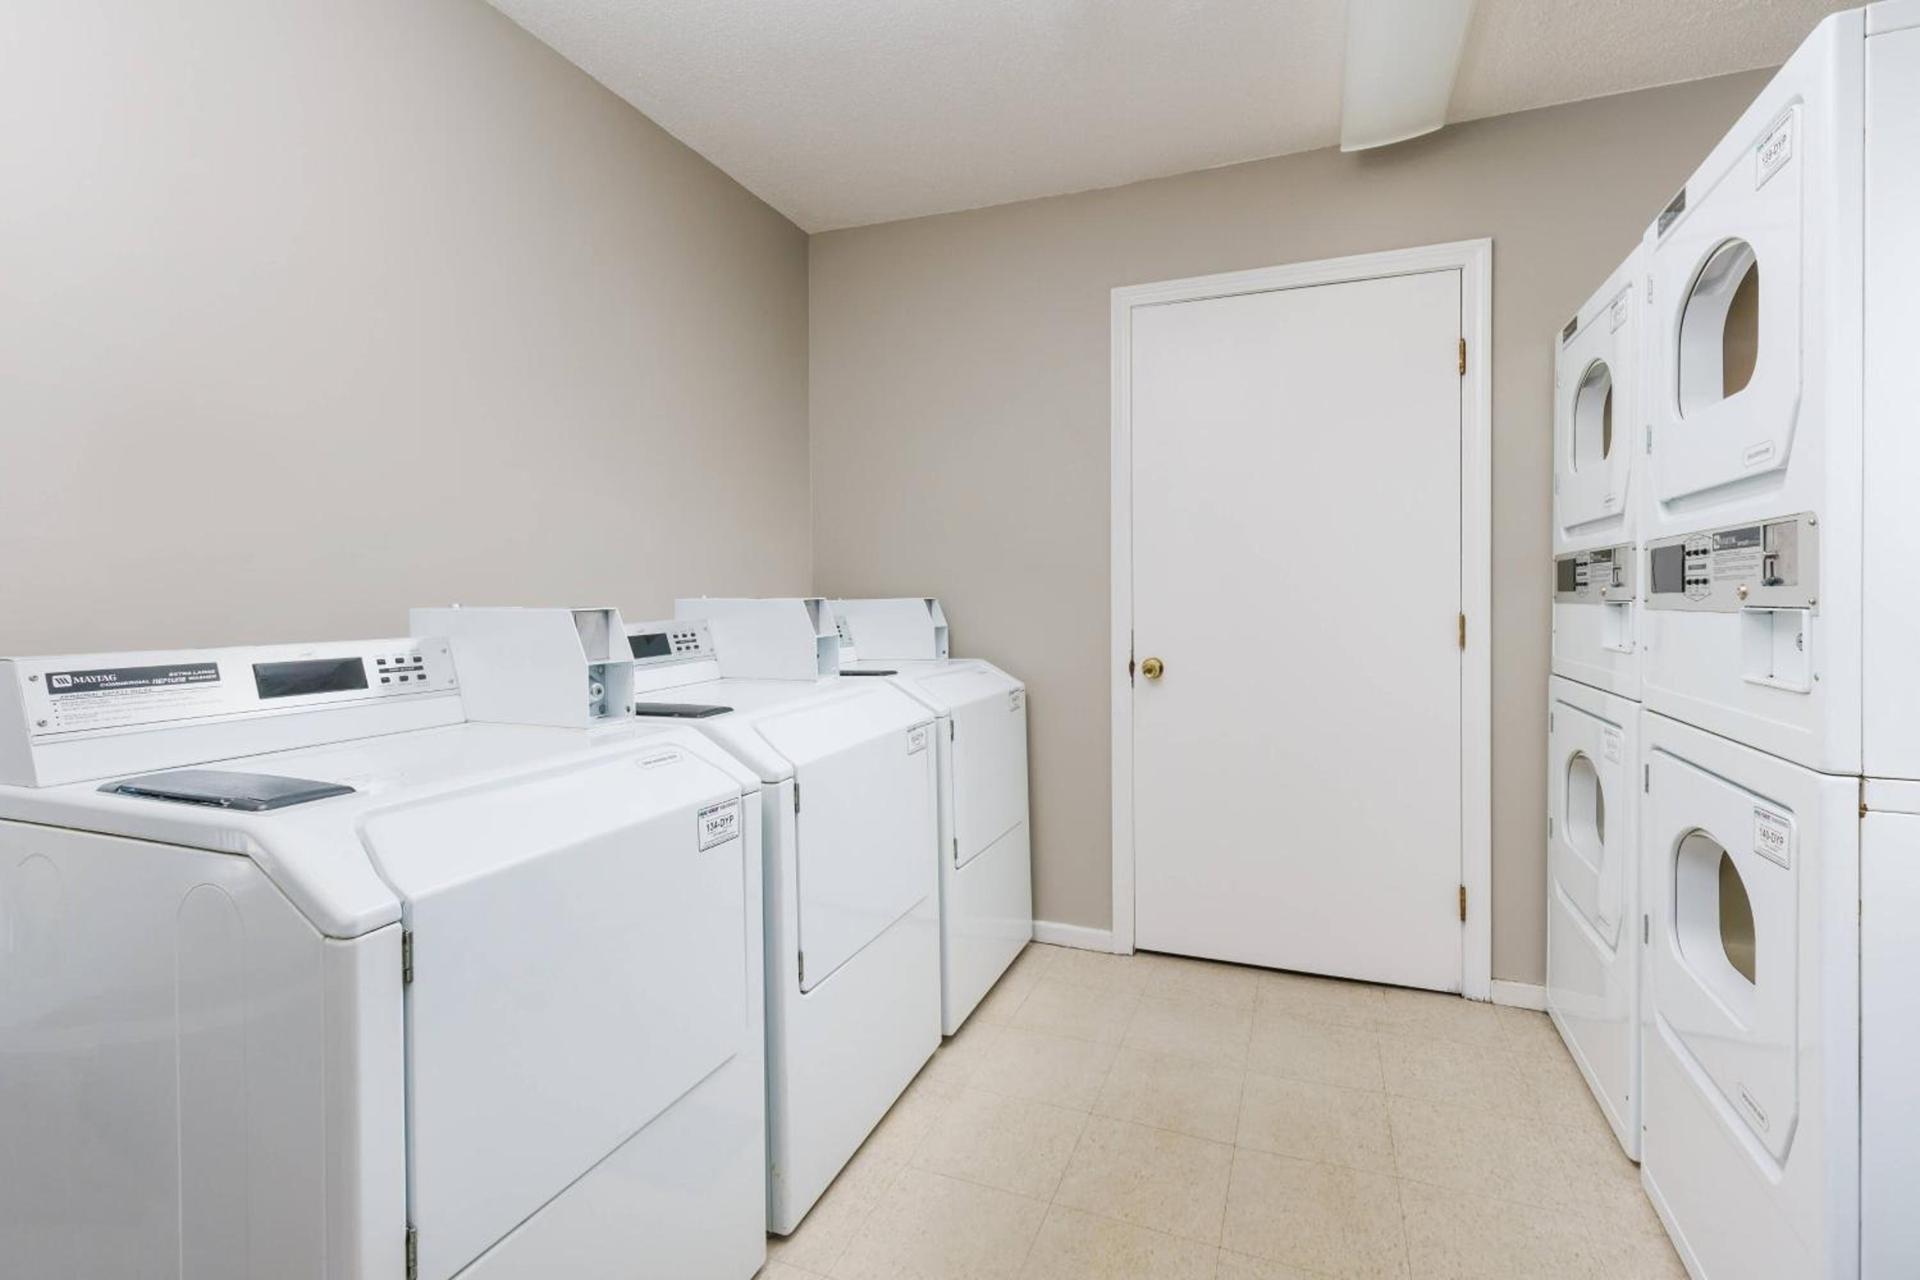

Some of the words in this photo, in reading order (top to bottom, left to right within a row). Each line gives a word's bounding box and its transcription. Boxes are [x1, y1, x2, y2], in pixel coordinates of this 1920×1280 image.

[73, 674, 117, 685] MAYTAG
[100, 680, 150, 688] COMMERCIAL
[706, 814, 735, 833] 134-DYP
